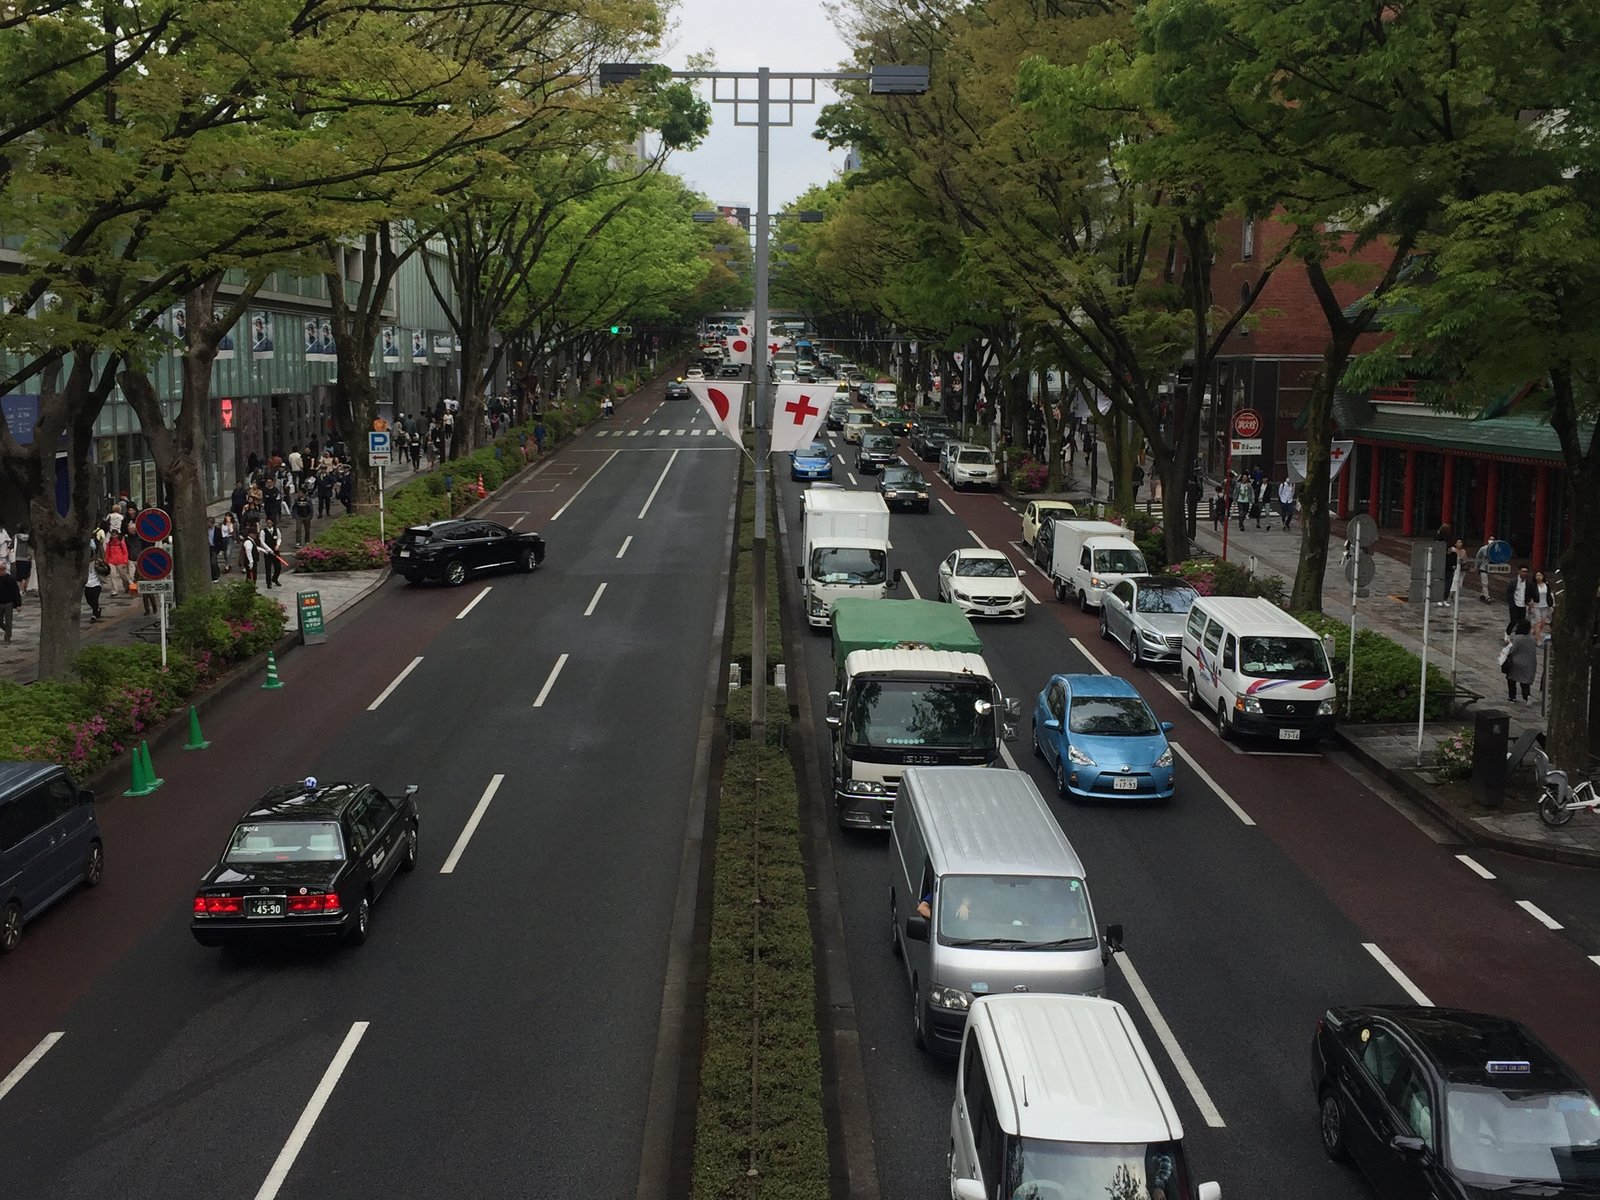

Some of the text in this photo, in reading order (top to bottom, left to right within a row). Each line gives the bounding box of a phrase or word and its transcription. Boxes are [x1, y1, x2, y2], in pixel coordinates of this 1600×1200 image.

[371, 433, 388, 451] P
[903, 755, 938, 763] ISUZU
[257, 904, 281, 914] 45-90
